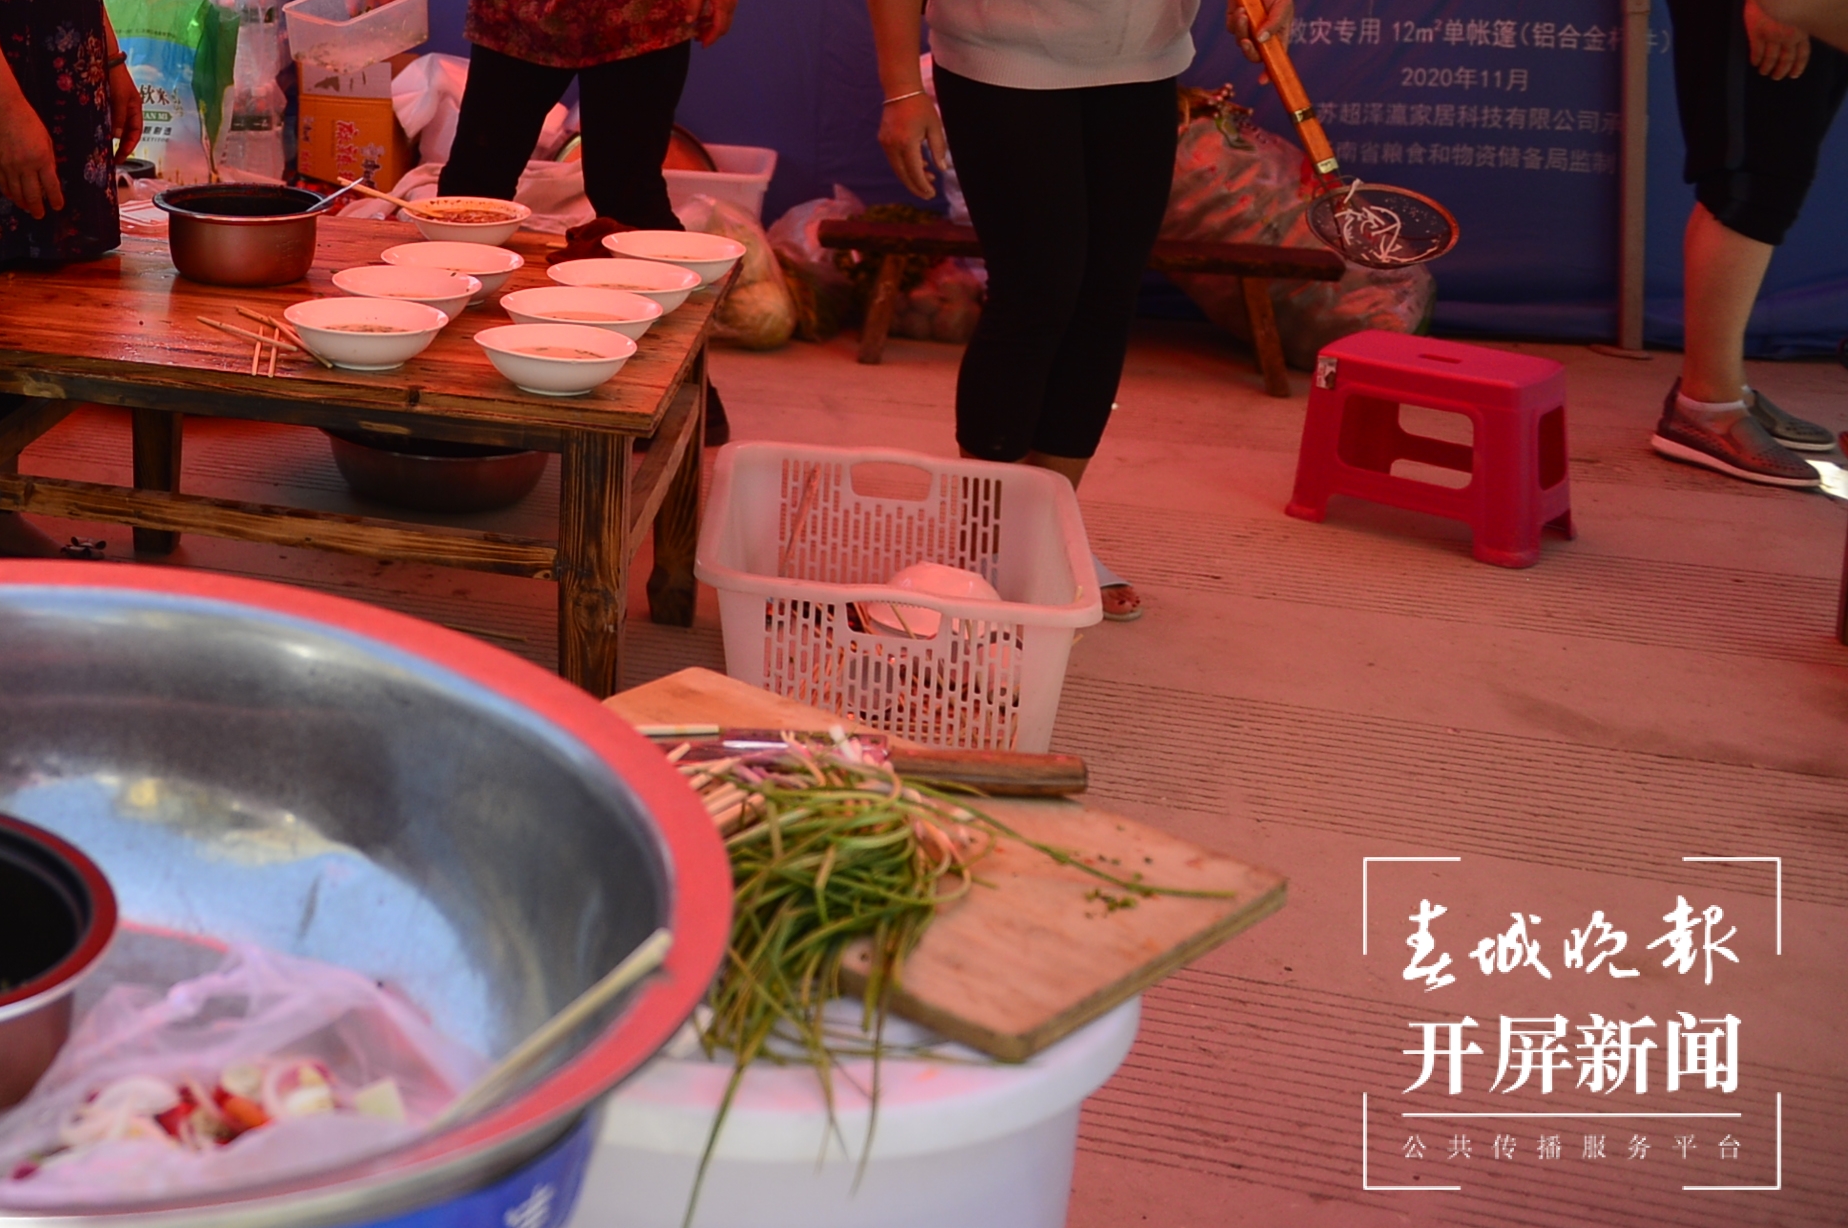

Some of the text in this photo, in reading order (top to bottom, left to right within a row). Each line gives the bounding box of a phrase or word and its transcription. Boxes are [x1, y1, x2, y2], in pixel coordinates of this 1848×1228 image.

[1402, 66, 1529, 92] 2020年11月
[1337, 141, 1617, 174] 南省粮食和物资储备局监制
